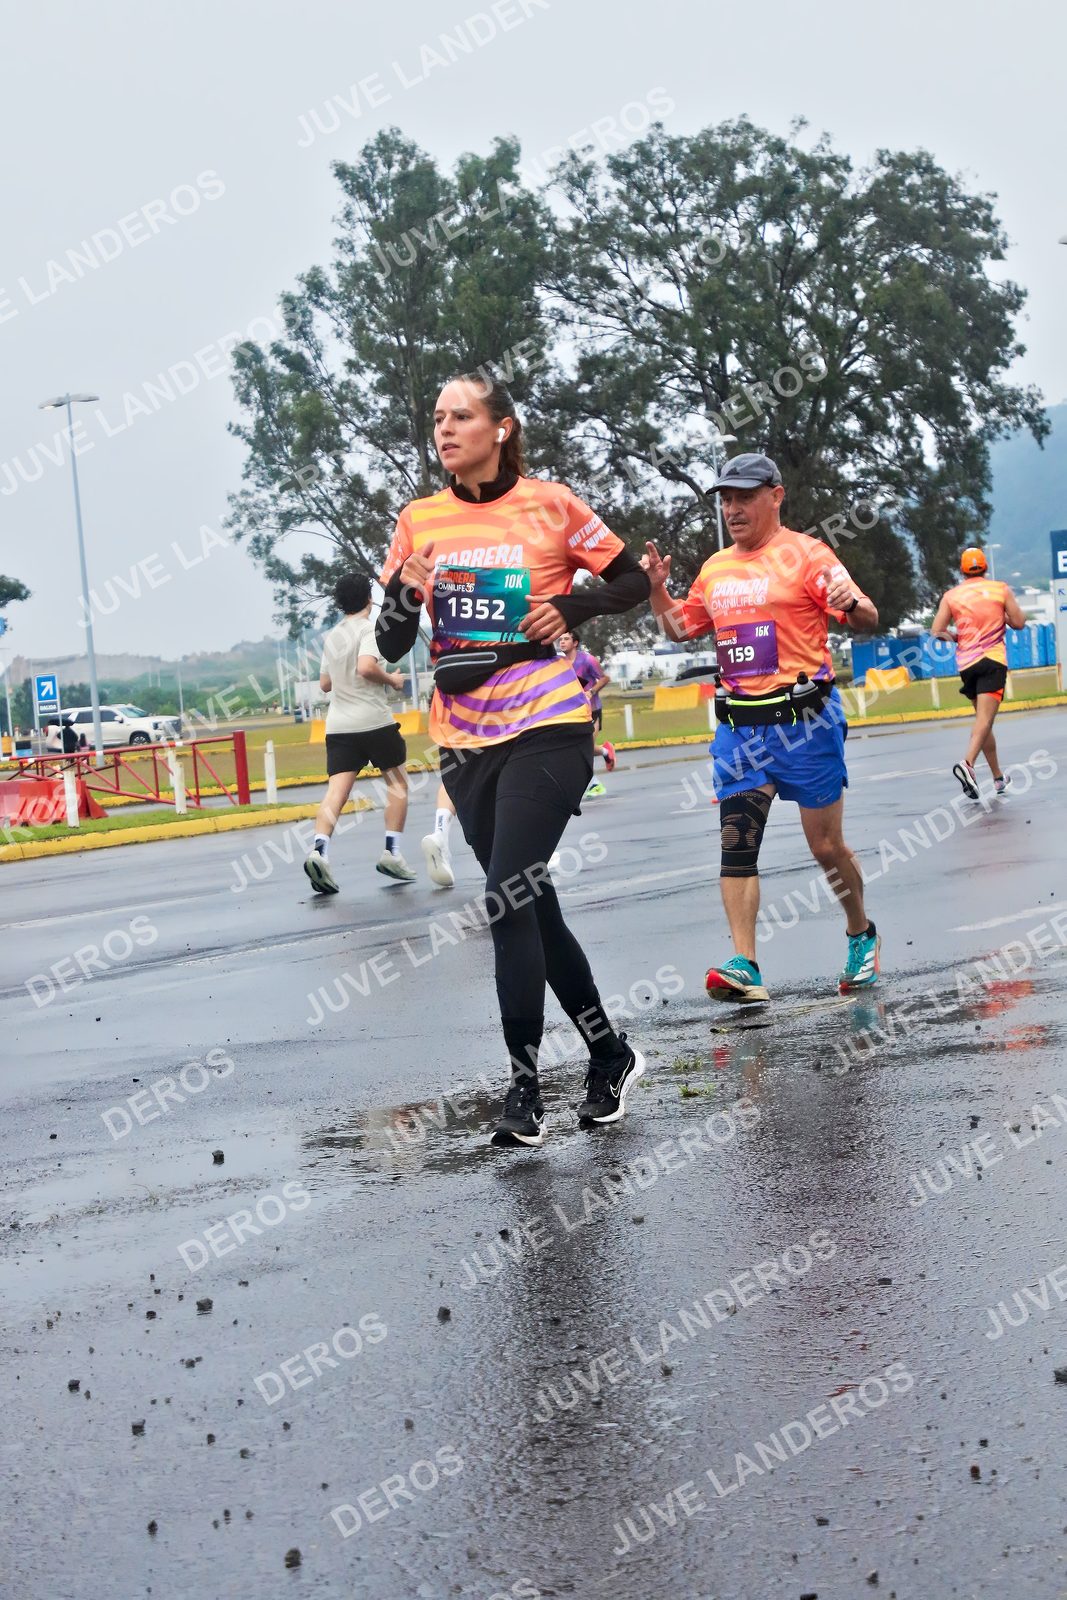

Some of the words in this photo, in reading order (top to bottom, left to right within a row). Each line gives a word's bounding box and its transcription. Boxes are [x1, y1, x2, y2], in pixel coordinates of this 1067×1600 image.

[434, 544, 523, 573] CARRERA
[438, 582, 465, 592] OMNILIFE
[504, 574, 524, 589] 10K
[448, 597, 505, 620] 1352
[711, 595, 753, 611] OMNILIFE
[755, 625, 770, 637] 16K
[727, 645, 755, 664] 159
